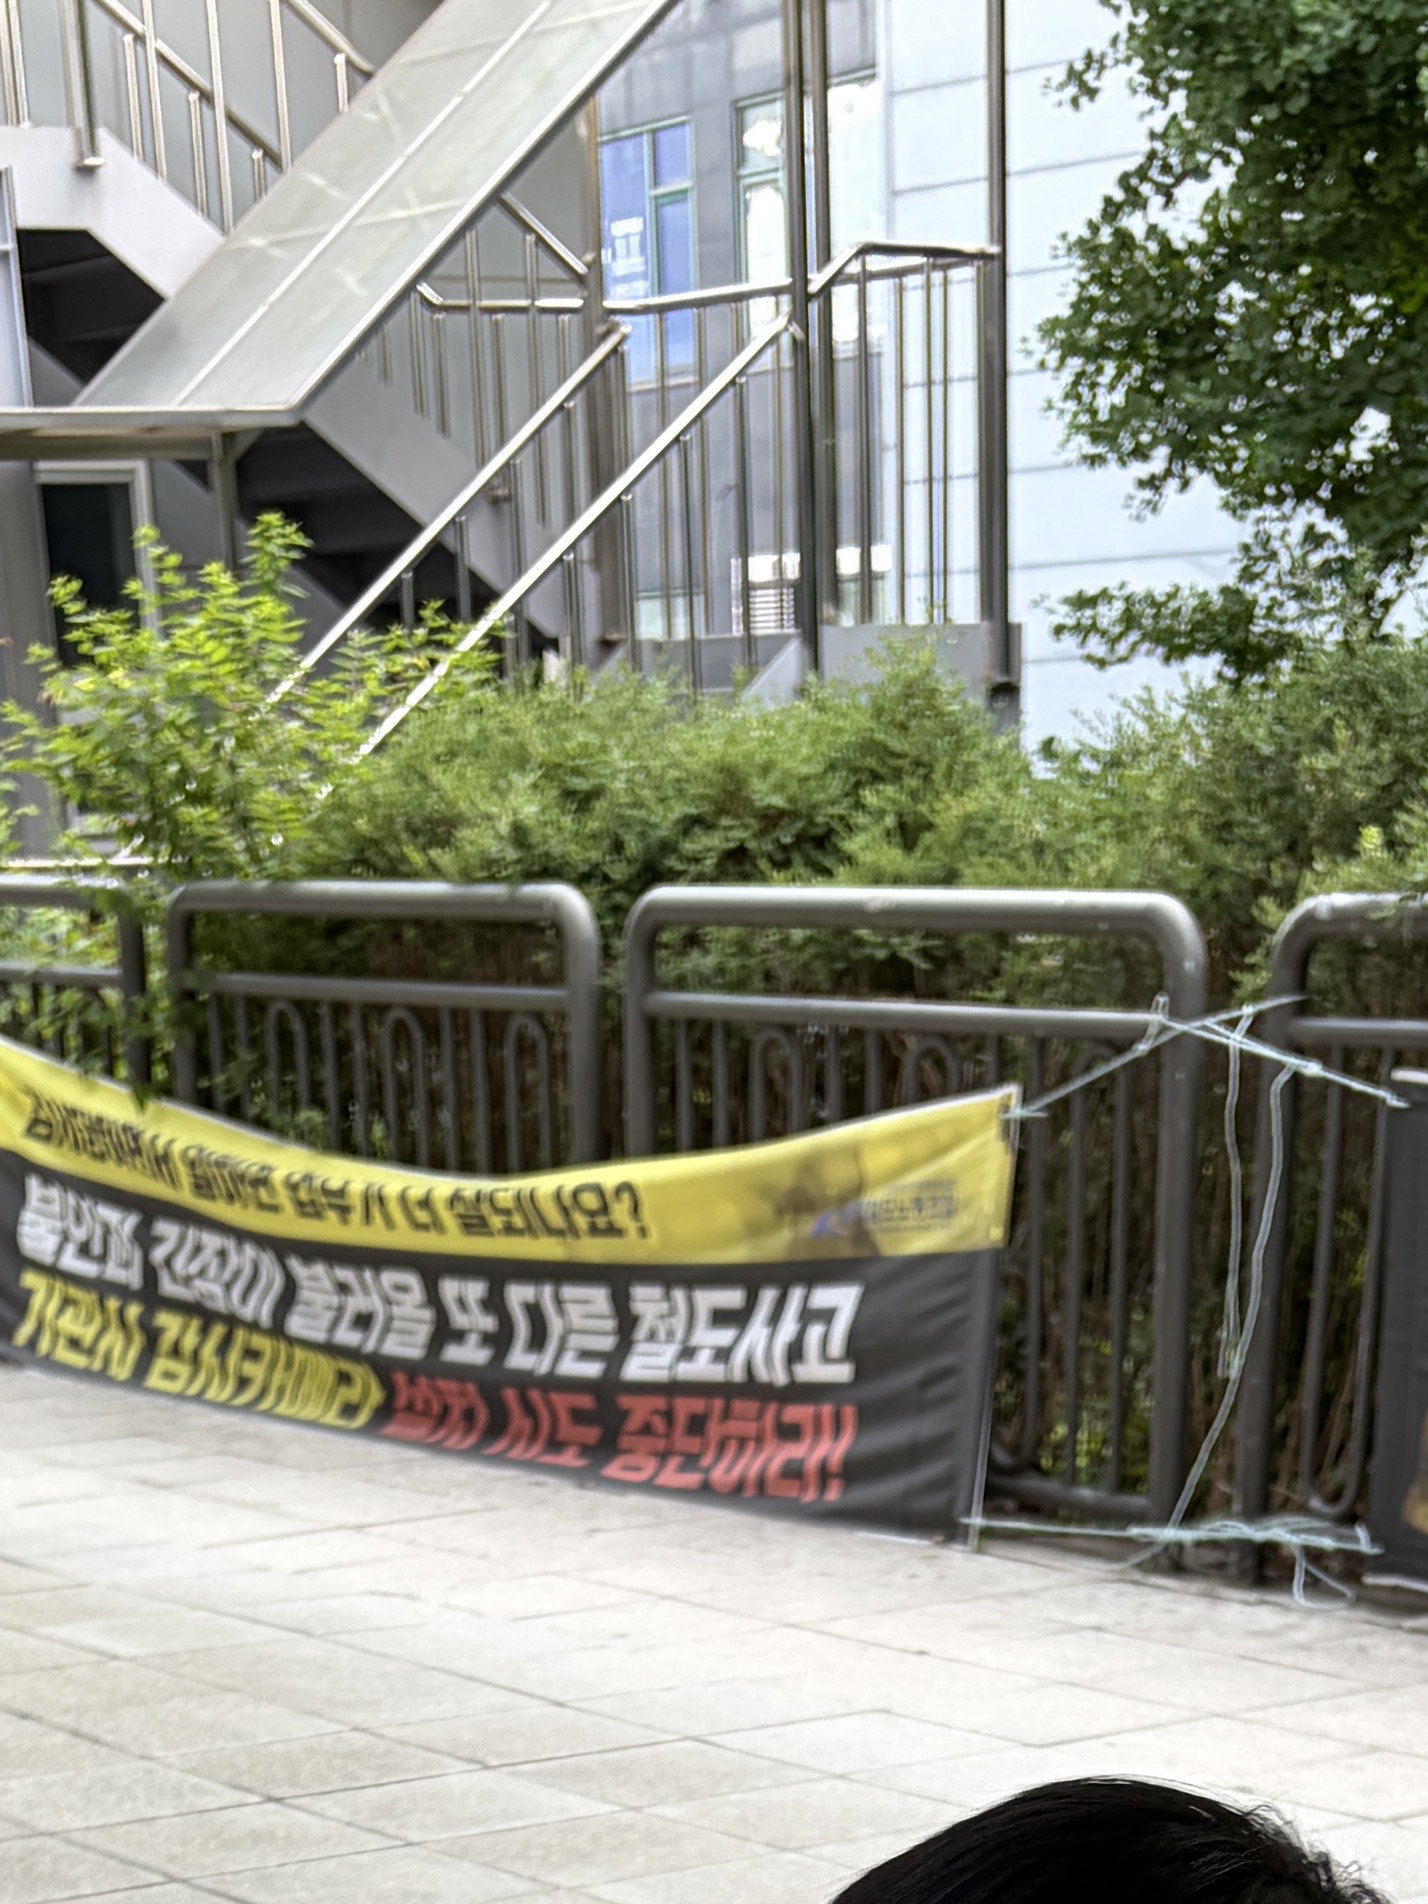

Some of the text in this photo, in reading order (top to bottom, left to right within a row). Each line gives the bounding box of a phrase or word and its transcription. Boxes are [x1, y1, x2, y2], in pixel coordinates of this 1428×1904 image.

[12, 1268, 147, 1382] 기관사
[482, 1387, 604, 1468] 시도
[600, 1393, 858, 1503] 중단하라!
[284, 1253, 436, 1361] 불러올
[438, 1273, 499, 1365] 또
[503, 1279, 619, 1377] 다른
[619, 1280, 864, 1386] 철도사고
